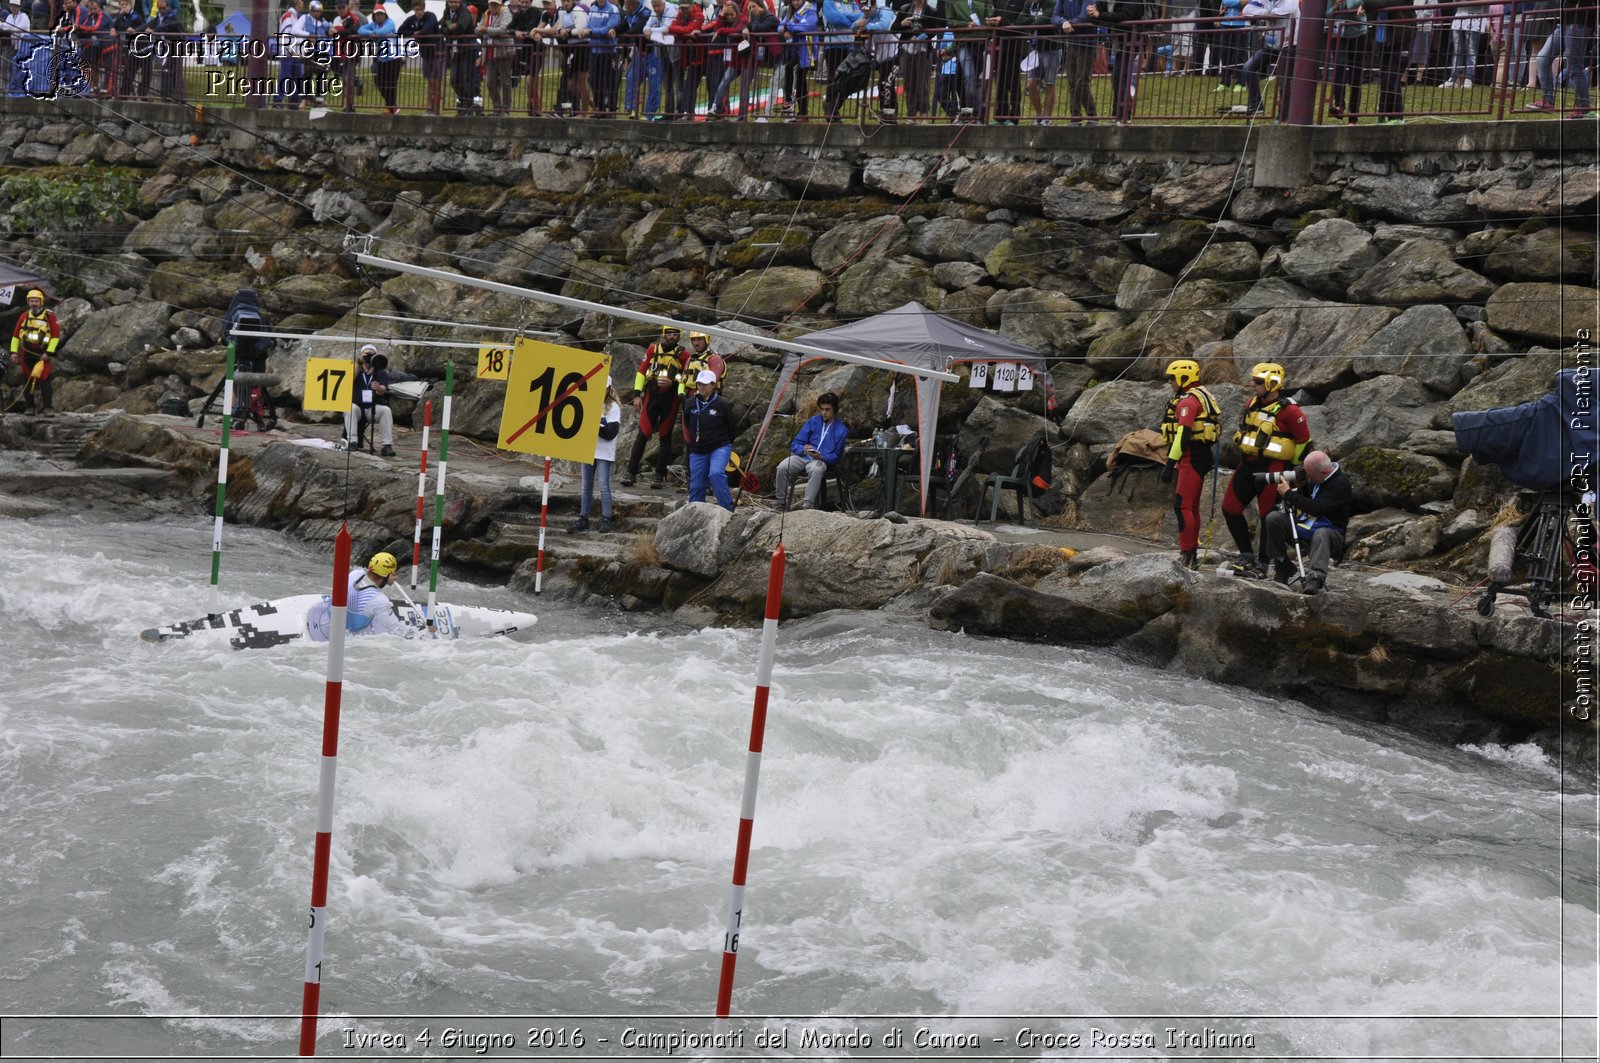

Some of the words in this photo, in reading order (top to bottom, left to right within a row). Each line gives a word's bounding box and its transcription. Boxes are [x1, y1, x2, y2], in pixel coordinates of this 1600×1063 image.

[486, 349, 504, 373] 18
[973, 365, 986, 378] 18
[316, 368, 346, 401] 17
[1005, 369, 1015, 381] 20
[1020, 368, 1032, 380] 21
[529, 366, 588, 440] 16
[435, 610, 450, 635] CZE
